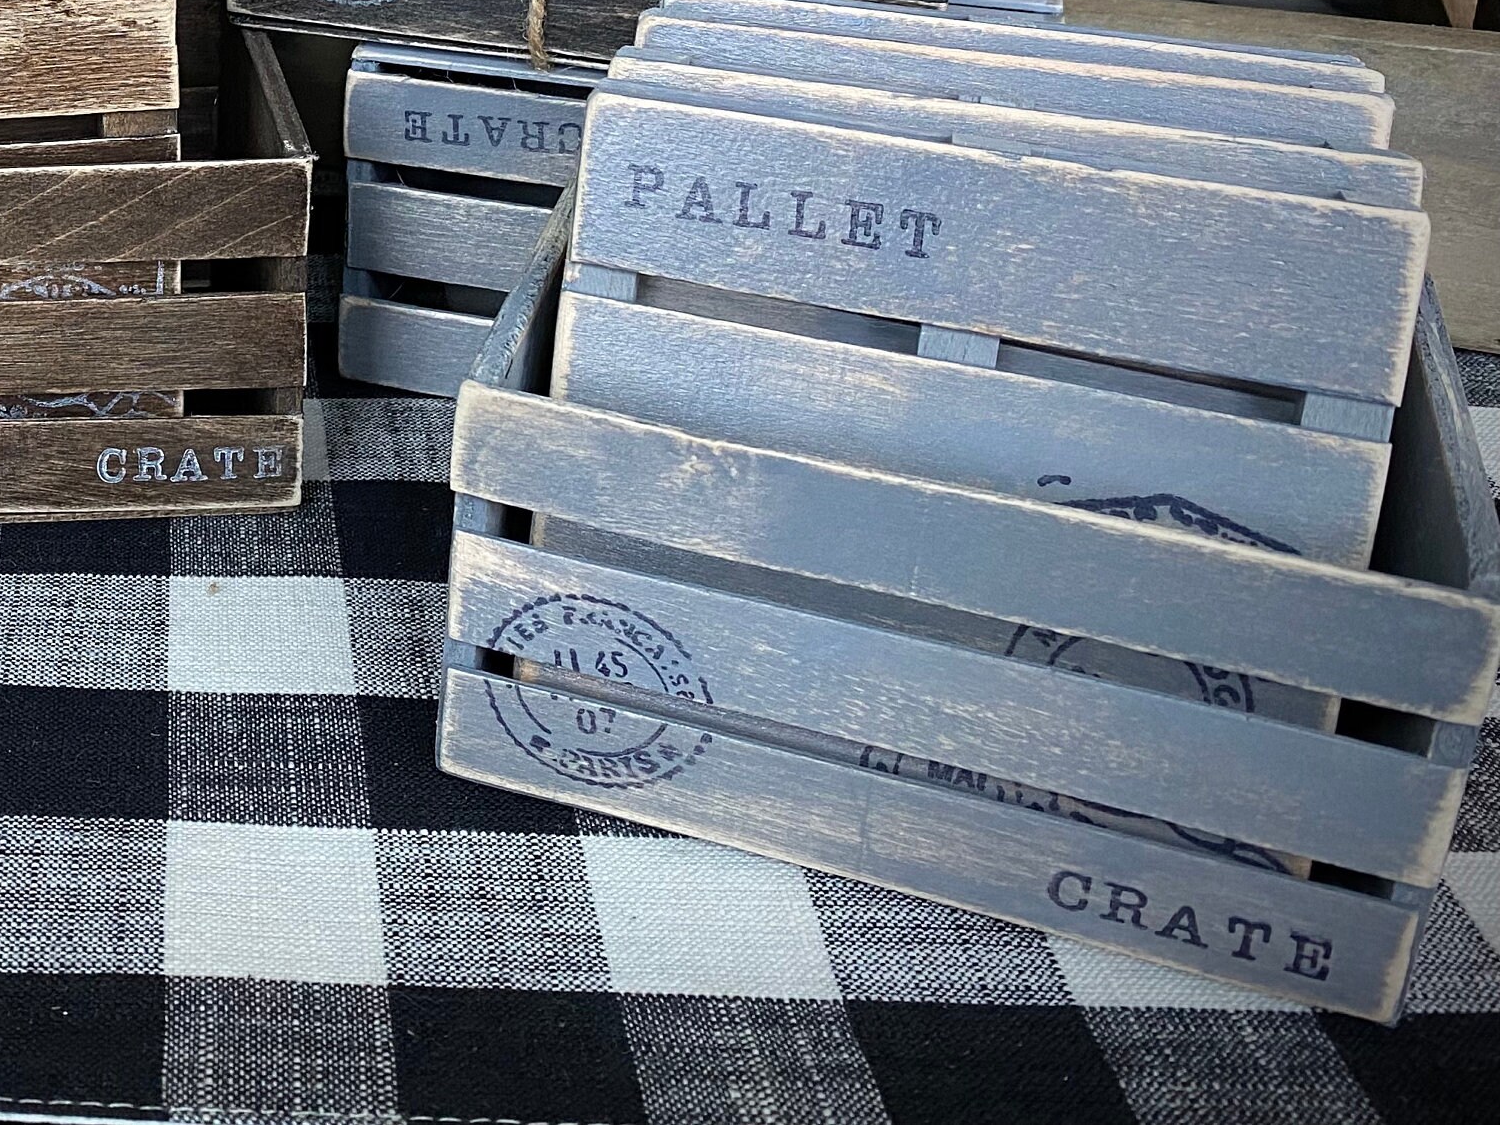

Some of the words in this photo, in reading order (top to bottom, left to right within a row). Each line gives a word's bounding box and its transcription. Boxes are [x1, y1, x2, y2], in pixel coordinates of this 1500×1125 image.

[404, 110, 583, 155] CRATE
[623, 162, 942, 259] PALLET
[96, 445, 286, 484] CRATE
[1047, 871, 1333, 981] CRATE
